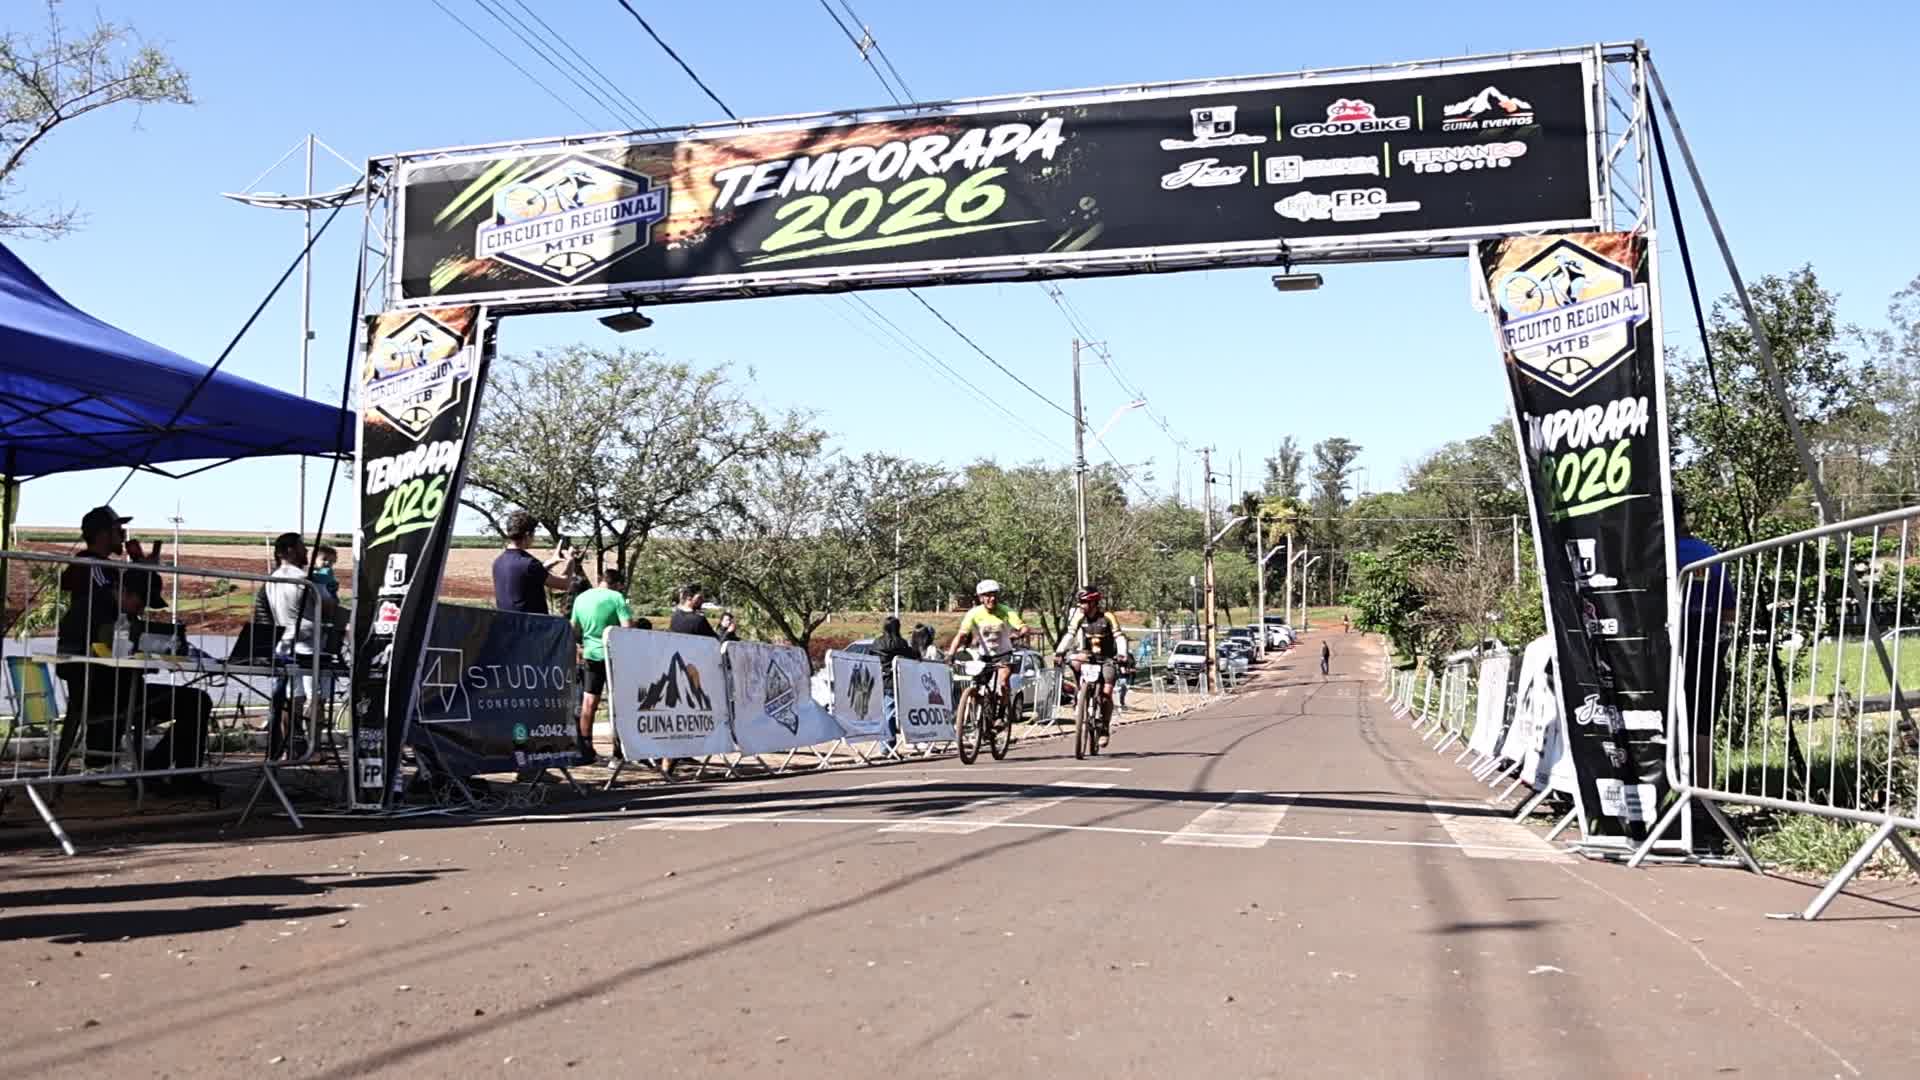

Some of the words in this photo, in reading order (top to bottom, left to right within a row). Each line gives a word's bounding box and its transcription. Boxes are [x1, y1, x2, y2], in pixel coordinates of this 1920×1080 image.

[1293, 122, 1355, 135] GOOD
[1360, 117, 1409, 131] BIKE
[1442, 121, 1478, 131] GUINA
[1482, 116, 1533, 128] EVENTOS
[715, 117, 1065, 209] TEMPORADA
[487, 220, 564, 248] CIRCUITO
[570, 193, 659, 231] REGIONAL
[760, 167, 1008, 252] 2026
[545, 232, 595, 254] MTB
[1567, 294, 1638, 329] REGIONAL
[1547, 336, 1589, 357] MTB
[1542, 438, 1631, 502] 026
[375, 474, 446, 533] 2026
[478, 697, 540, 710] CONFORTO
[637, 715, 674, 733] GUINA
[676, 714, 715, 732] EVENTOS
[908, 707, 943, 726] GOOD
